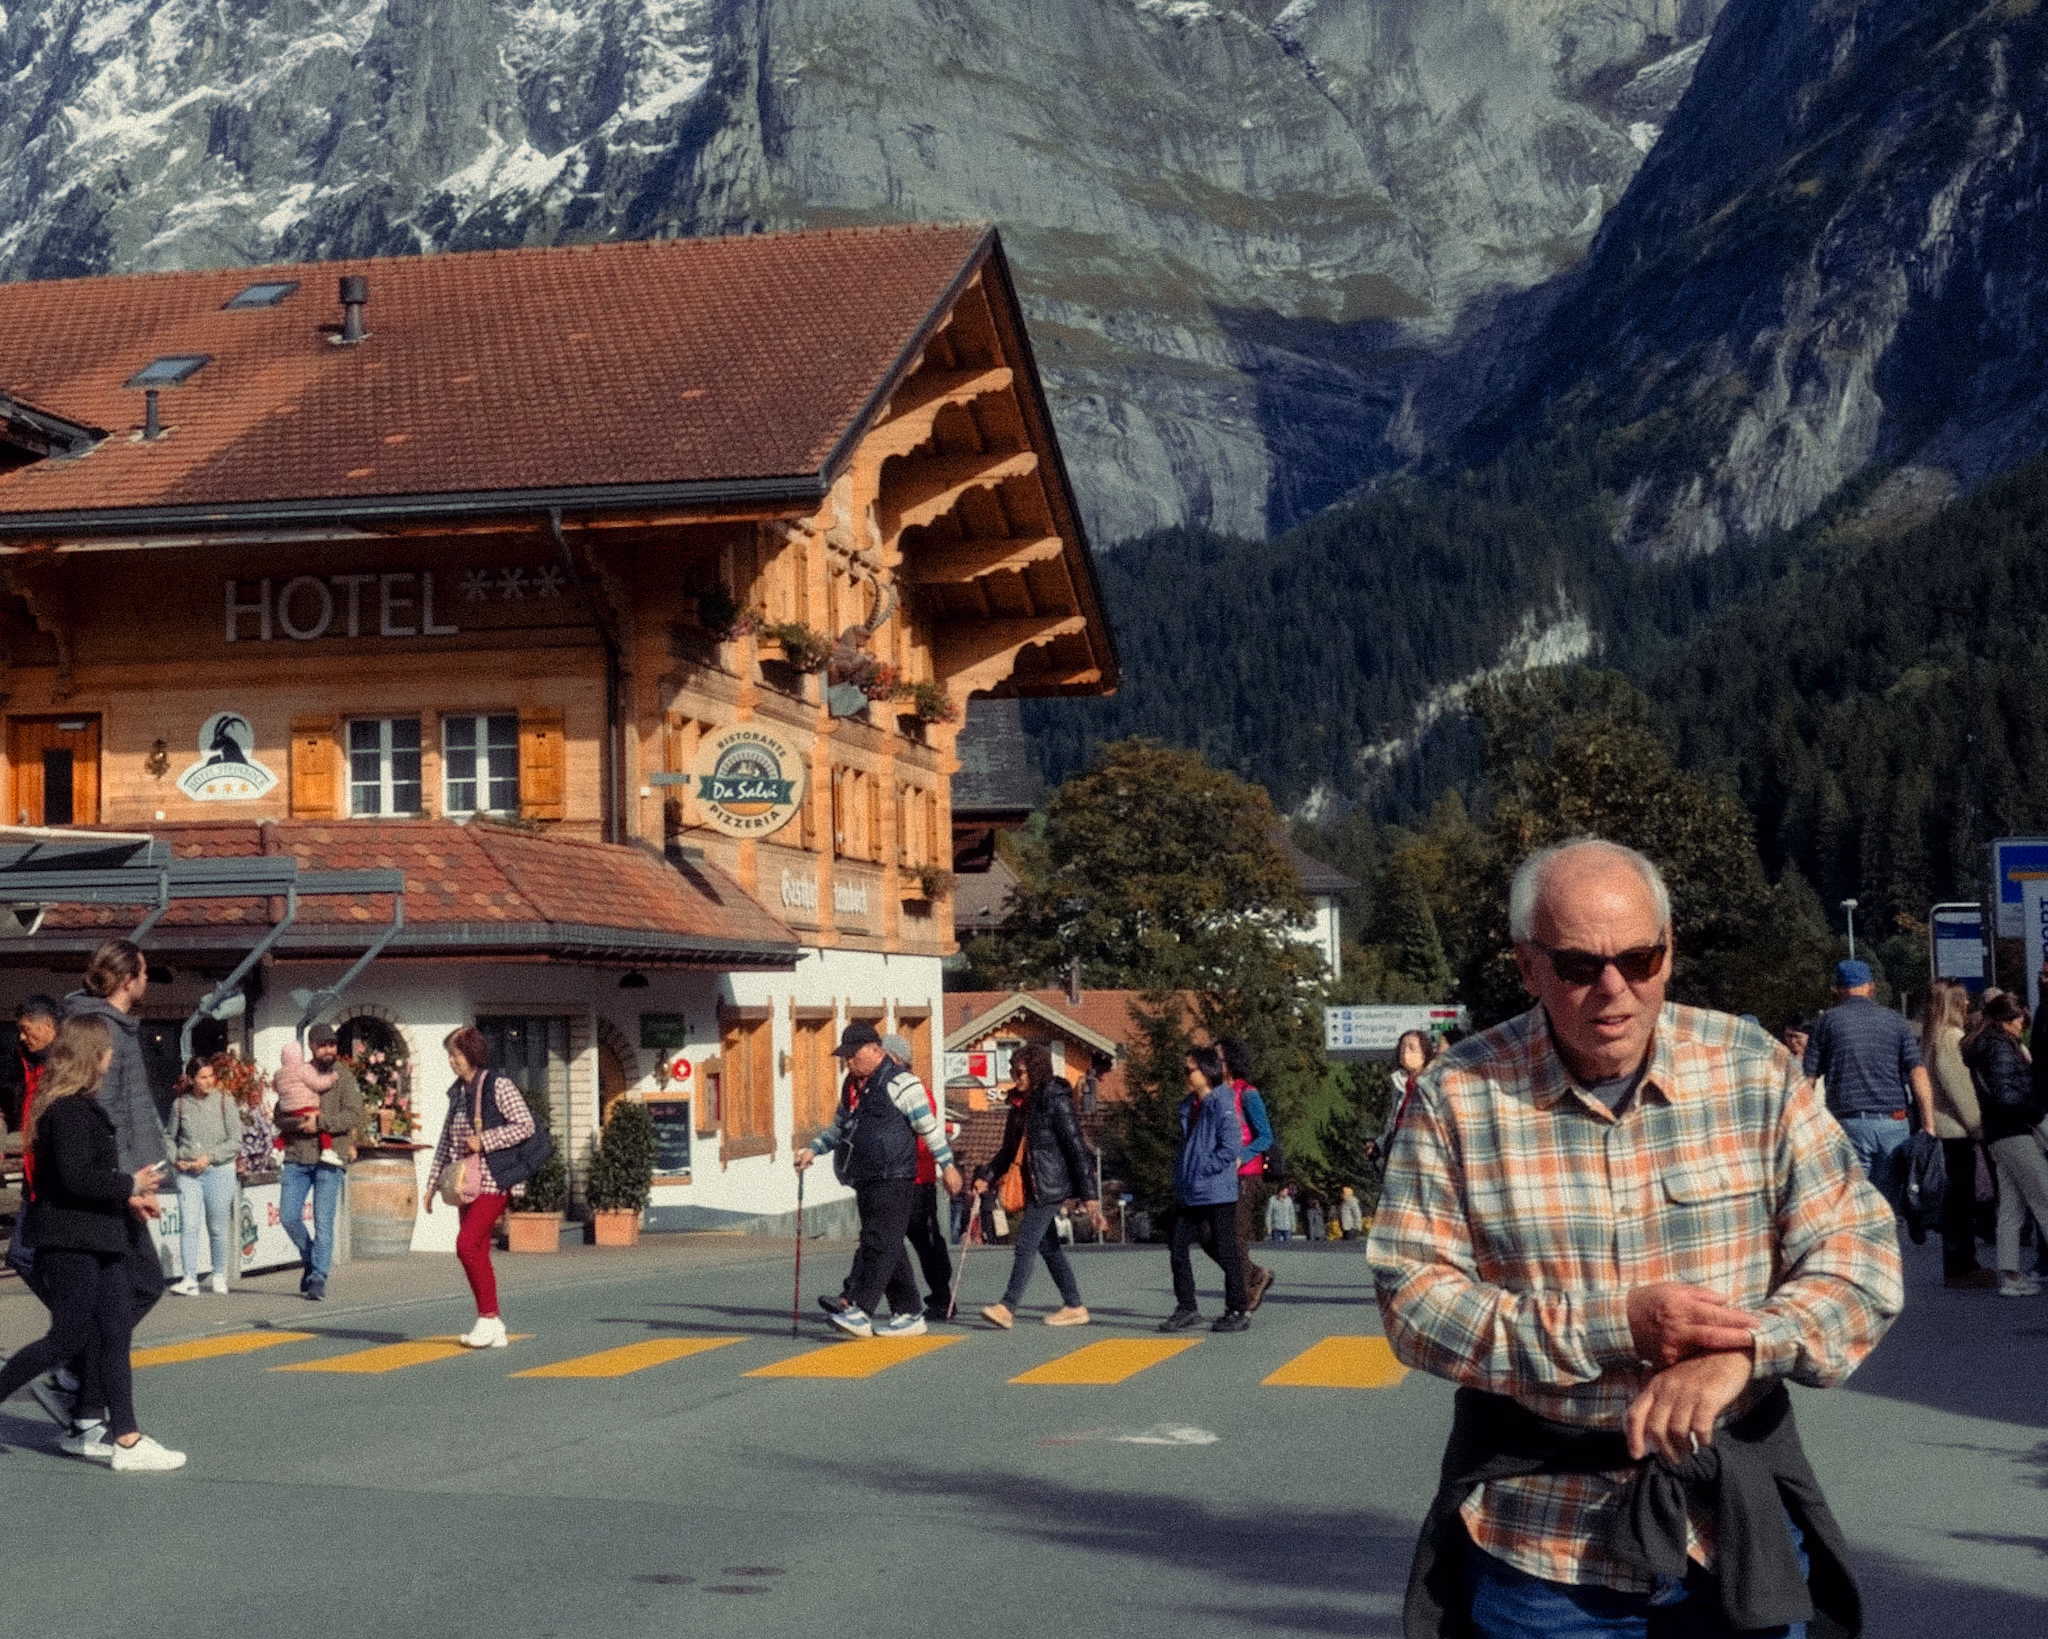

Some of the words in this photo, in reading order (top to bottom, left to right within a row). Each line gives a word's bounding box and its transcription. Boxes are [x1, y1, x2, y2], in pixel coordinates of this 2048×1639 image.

[224, 571, 459, 642] HOTEL
[716, 731, 787, 759] RISTORANTE
[712, 781, 734, 800] Da
[737, 781, 778, 800] Salvi
[708, 803, 781, 829] PIZZERIA
